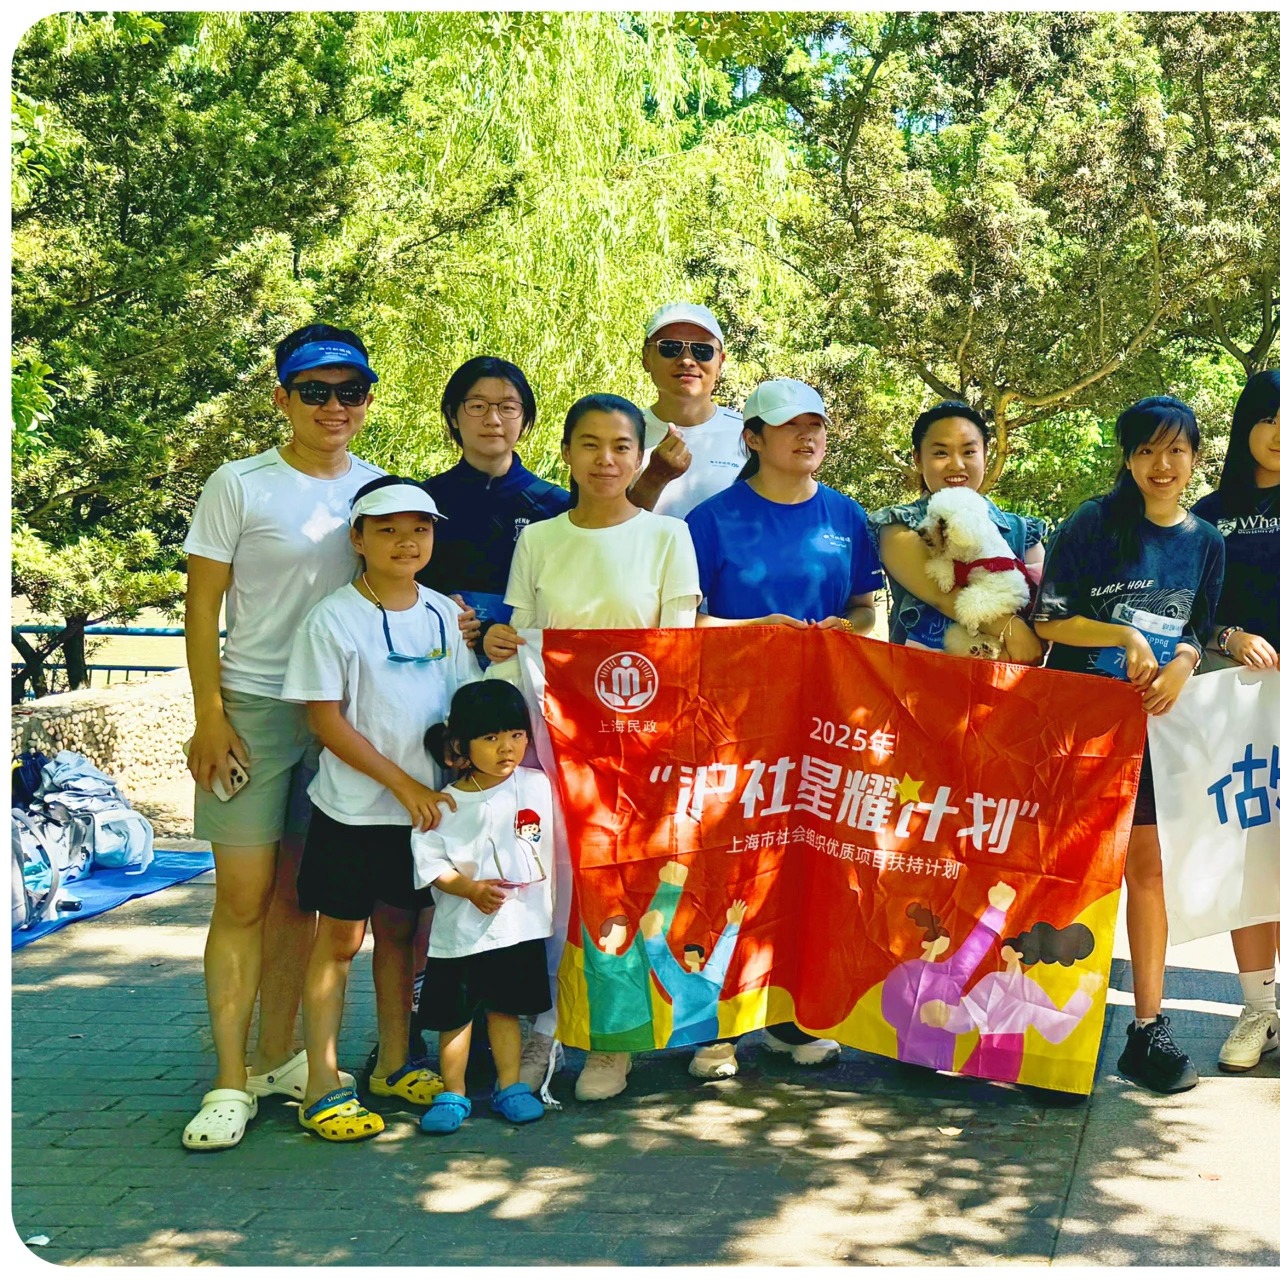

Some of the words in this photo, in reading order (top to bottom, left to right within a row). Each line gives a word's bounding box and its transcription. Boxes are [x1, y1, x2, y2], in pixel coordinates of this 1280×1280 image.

[1090, 582, 1125, 597] BLACK
[1127, 579, 1154, 591] HOLE
[598, 719, 658, 734] 上海民政
[809, 716, 897, 756] 2025年
[726, 824, 961, 880] 上海市社会组织优质项目扶持计划
